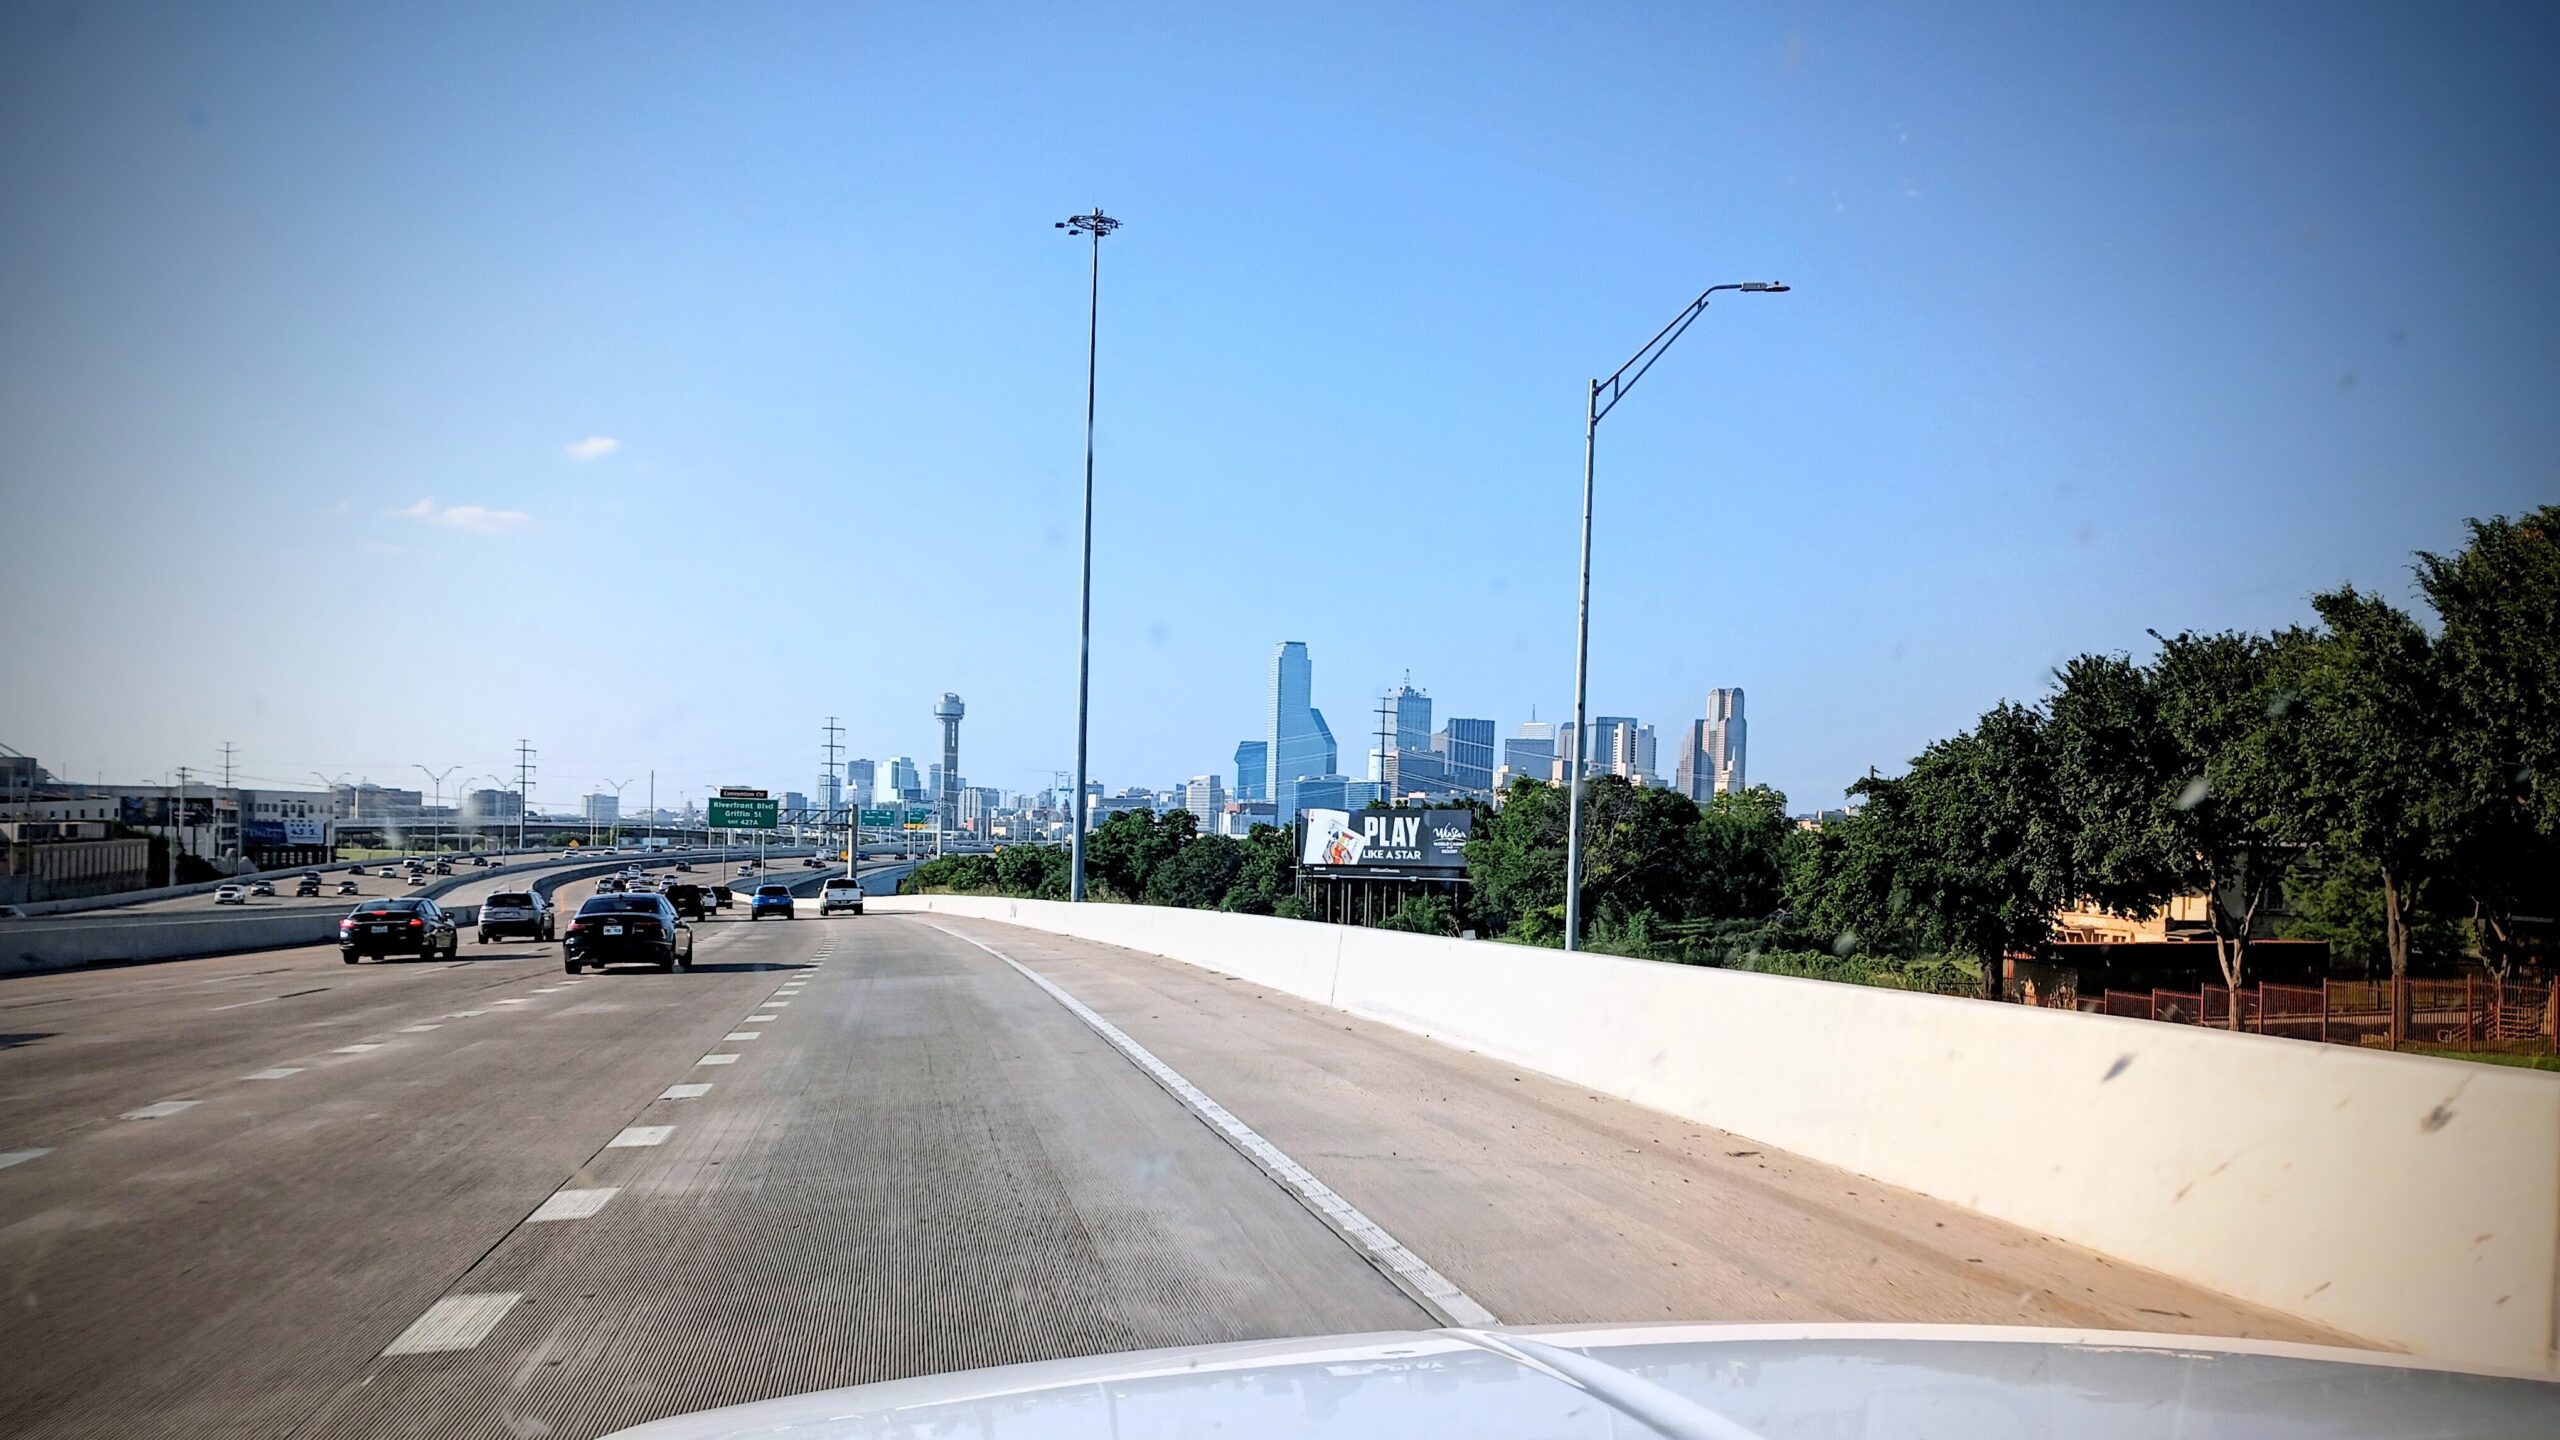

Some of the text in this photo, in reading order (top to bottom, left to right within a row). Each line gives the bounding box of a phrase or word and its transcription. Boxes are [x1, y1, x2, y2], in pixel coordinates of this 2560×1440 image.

[1364, 816, 1420, 848] PLAY
[1432, 822, 1466, 840] WinStar
[1362, 850, 1421, 860] LIKE A STAR
